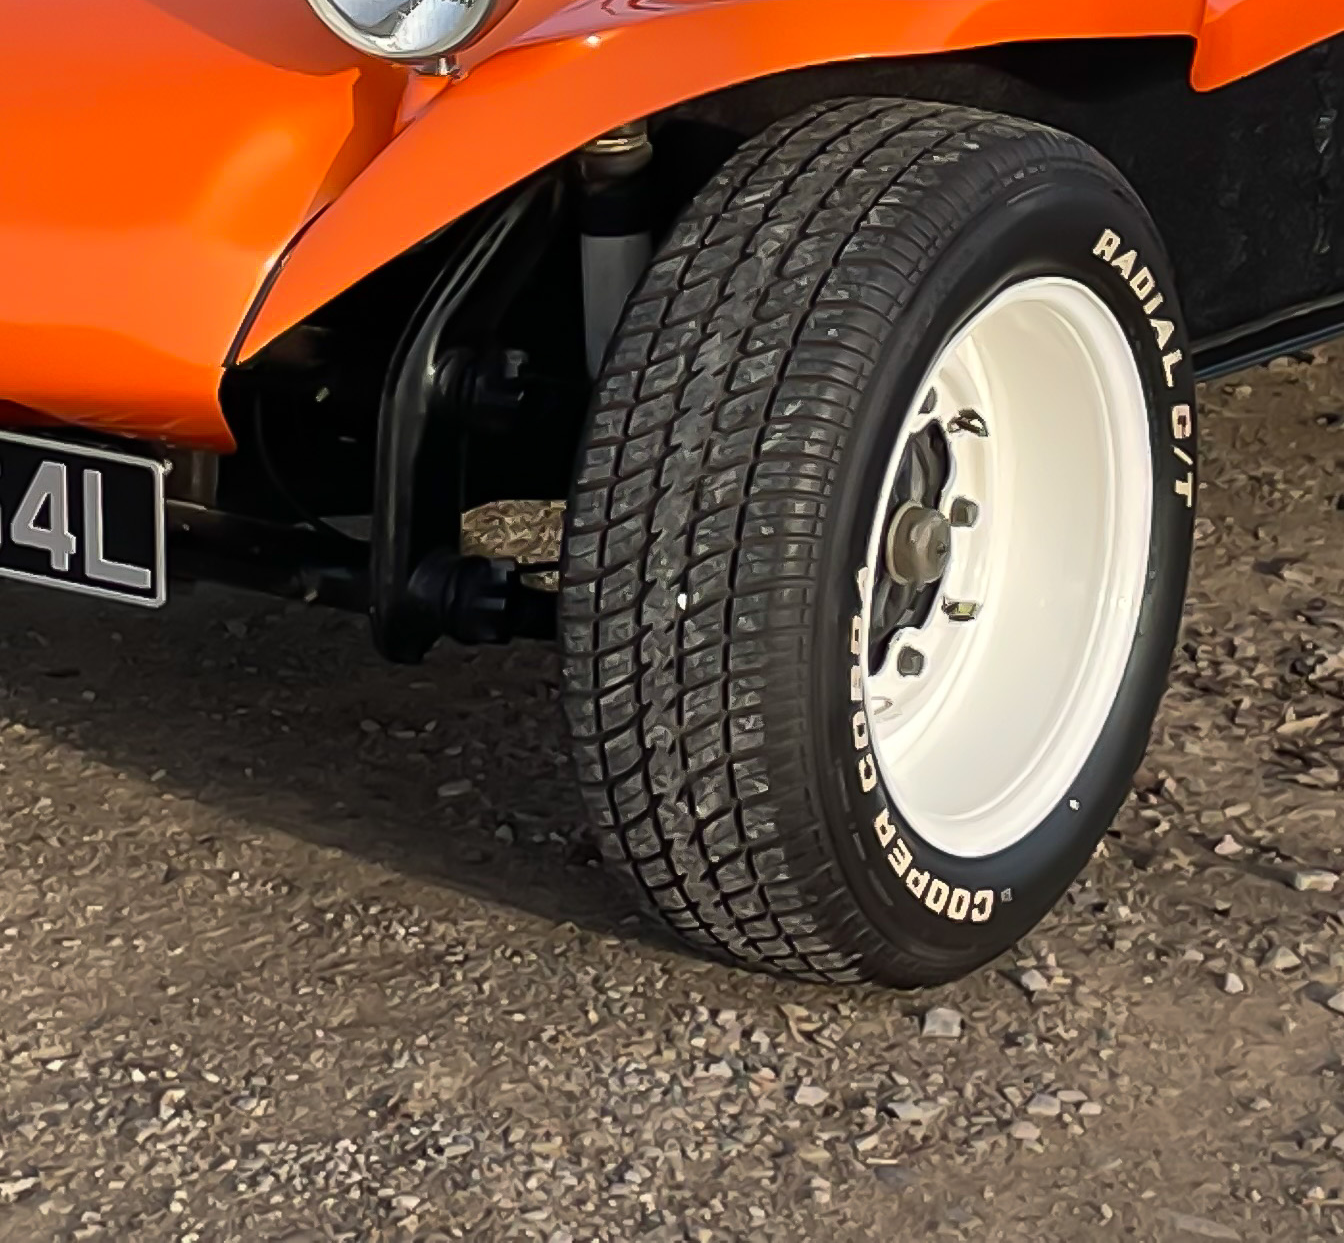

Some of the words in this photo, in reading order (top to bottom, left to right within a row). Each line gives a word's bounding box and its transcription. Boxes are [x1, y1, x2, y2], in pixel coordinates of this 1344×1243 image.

[1092, 228, 1183, 388] RADIAL
[1171, 403, 1194, 508] G/T
[873, 807, 994, 925] COOPER
